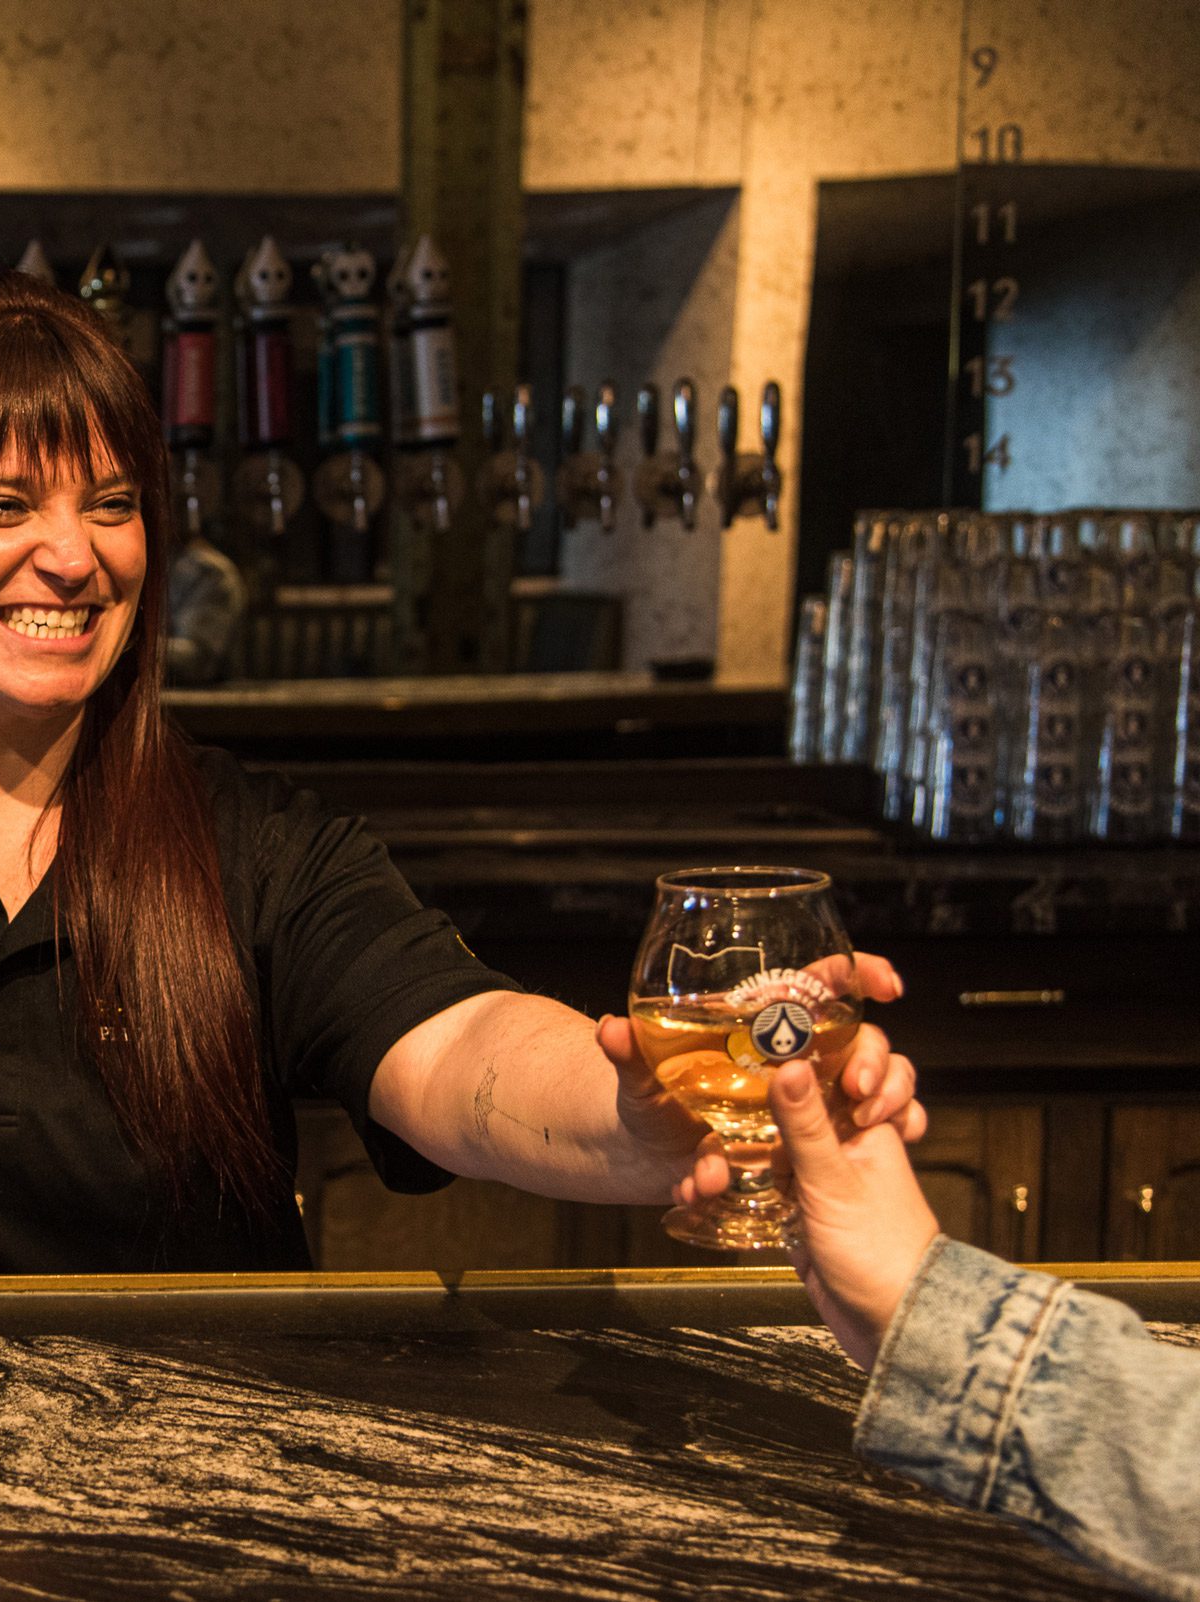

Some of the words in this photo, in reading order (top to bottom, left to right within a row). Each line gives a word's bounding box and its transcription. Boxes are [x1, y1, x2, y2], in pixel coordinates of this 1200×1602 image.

[972, 47, 997, 88] 9
[974, 123, 1023, 165] 10
[971, 202, 1017, 245] 11
[968, 276, 1020, 321] 12
[965, 355, 1015, 397] 13
[963, 433, 1011, 475] 14
